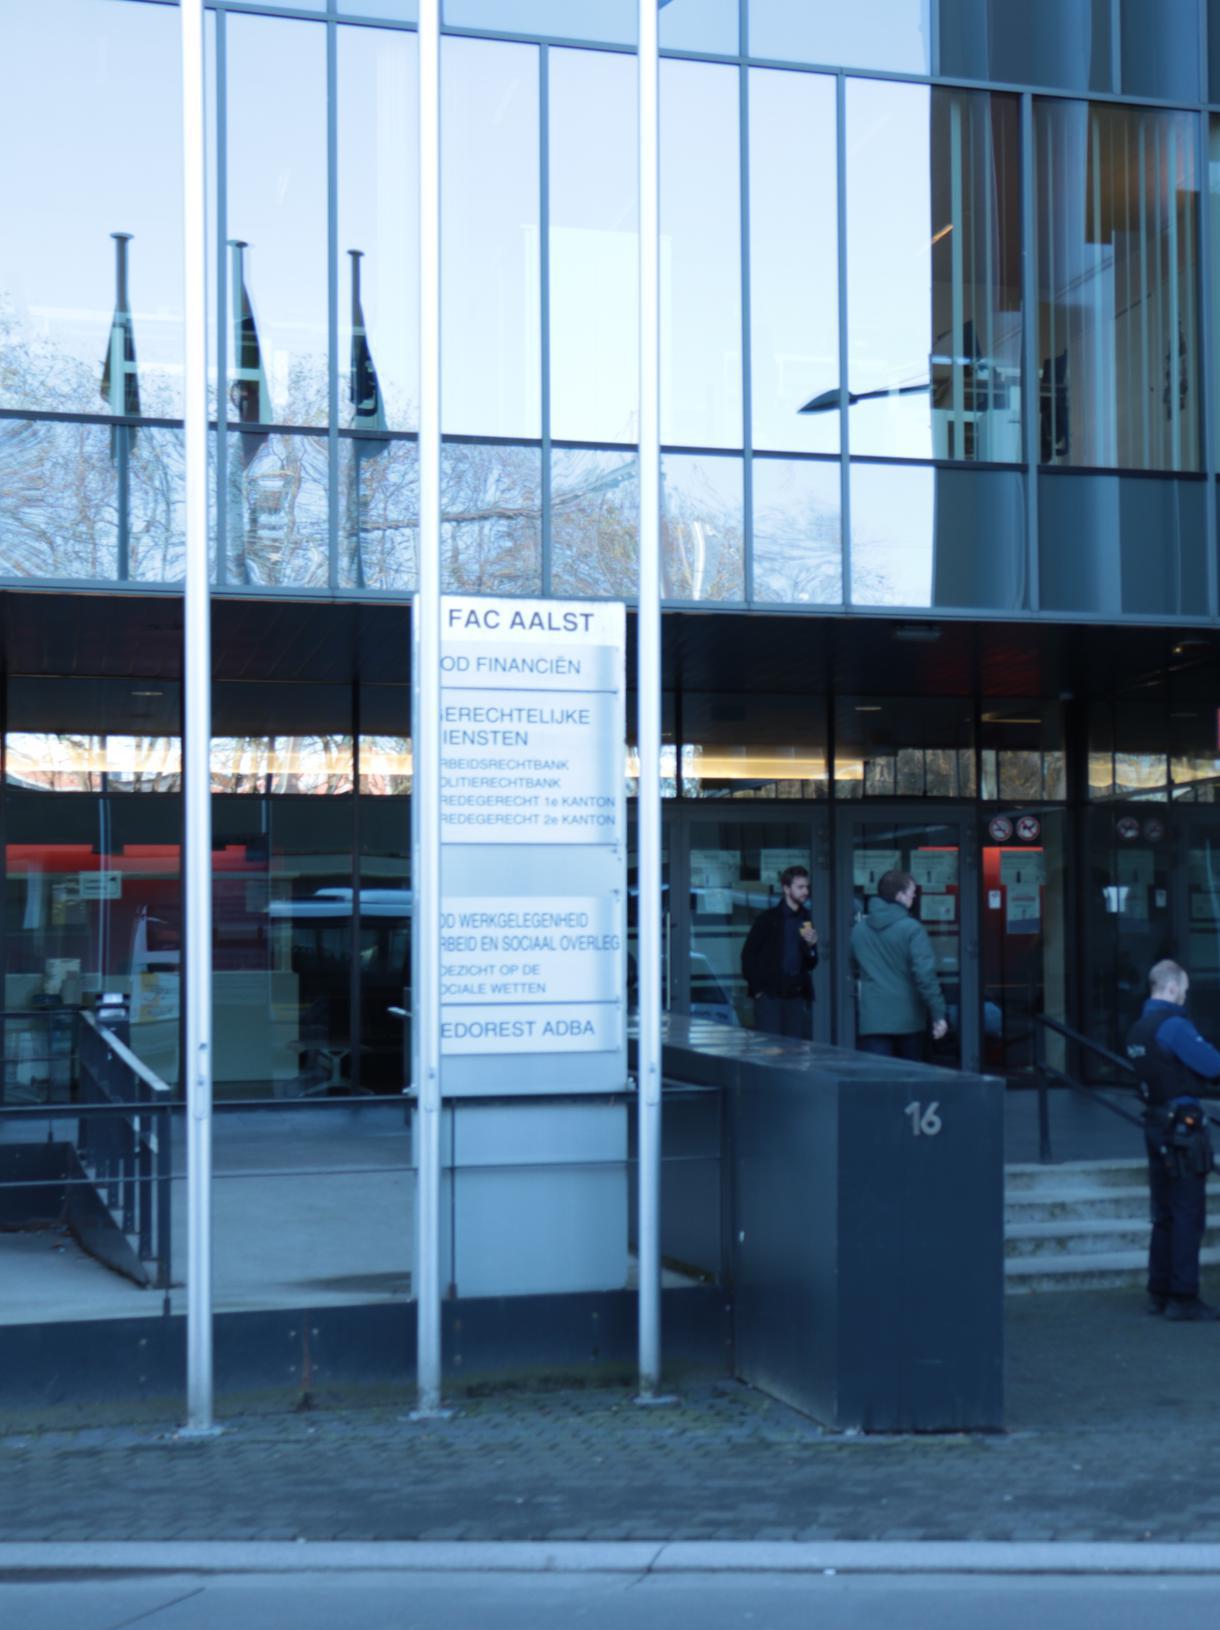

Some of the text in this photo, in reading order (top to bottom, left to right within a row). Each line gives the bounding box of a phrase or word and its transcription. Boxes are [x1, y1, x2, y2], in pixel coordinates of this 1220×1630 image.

[448, 608, 595, 632] FAC AALST
[476, 655, 582, 675] FINANCIËN
[440, 706, 590, 725] ERECHTELIJKE
[561, 796, 616, 808] KANTON
[561, 814, 616, 826] KANTON
[459, 911, 589, 929] WERKGELEGENHEID
[481, 936, 499, 952] EN
[502, 935, 557, 952] SOCIAAL
[560, 935, 620, 952] OVERLEG
[499, 964, 519, 977] OP
[522, 964, 541, 976] DE
[490, 982, 547, 995] WETTEN
[542, 1019, 596, 1037] ADBA
[904, 1101, 942, 1136] 16
